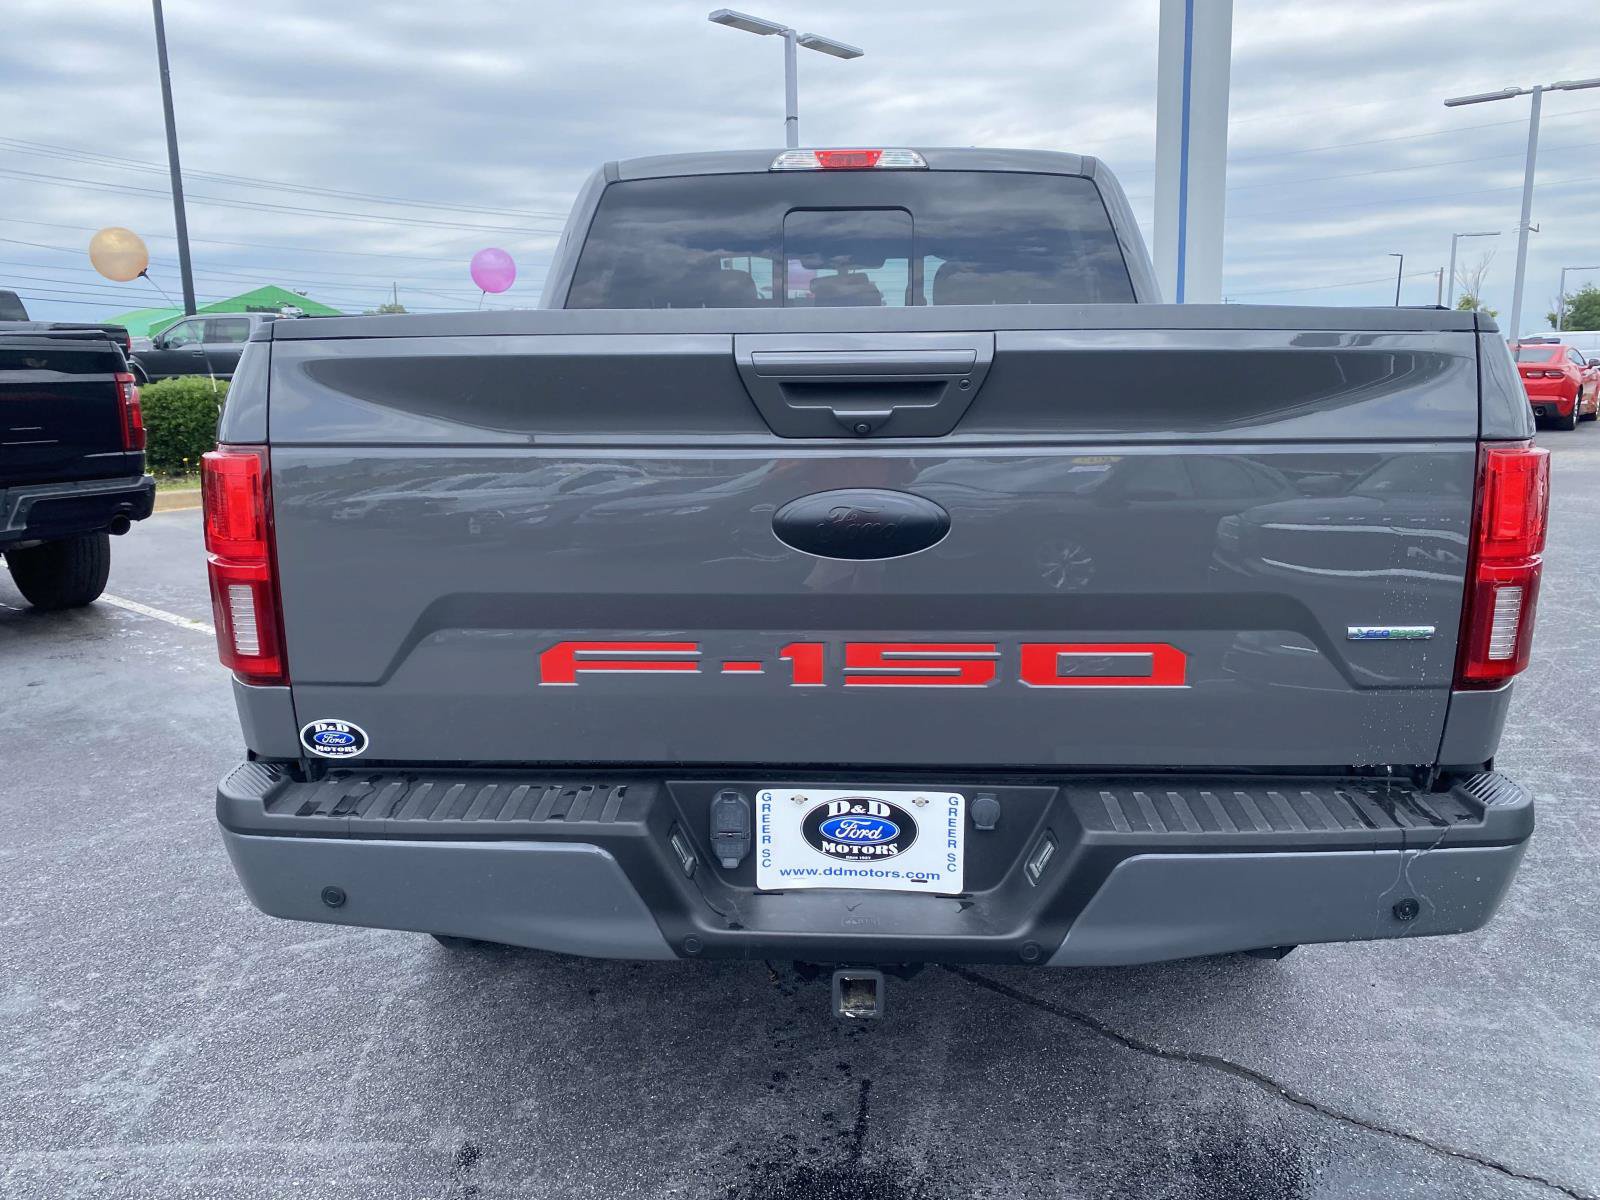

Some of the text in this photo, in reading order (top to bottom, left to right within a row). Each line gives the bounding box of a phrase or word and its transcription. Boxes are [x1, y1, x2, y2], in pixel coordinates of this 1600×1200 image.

[538, 641, 1192, 690] F-150
[314, 723, 350, 732] D&D
[321, 733, 347, 744] Ford
[315, 745, 358, 753] MOTORS
[827, 800, 891, 817] D&D
[761, 792, 772, 868] GREER SC
[835, 819, 883, 840] Ford
[946, 796, 959, 873] GREER SC
[821, 840, 899, 856] MOTORS
[779, 866, 941, 881] www.ddmotors.com
